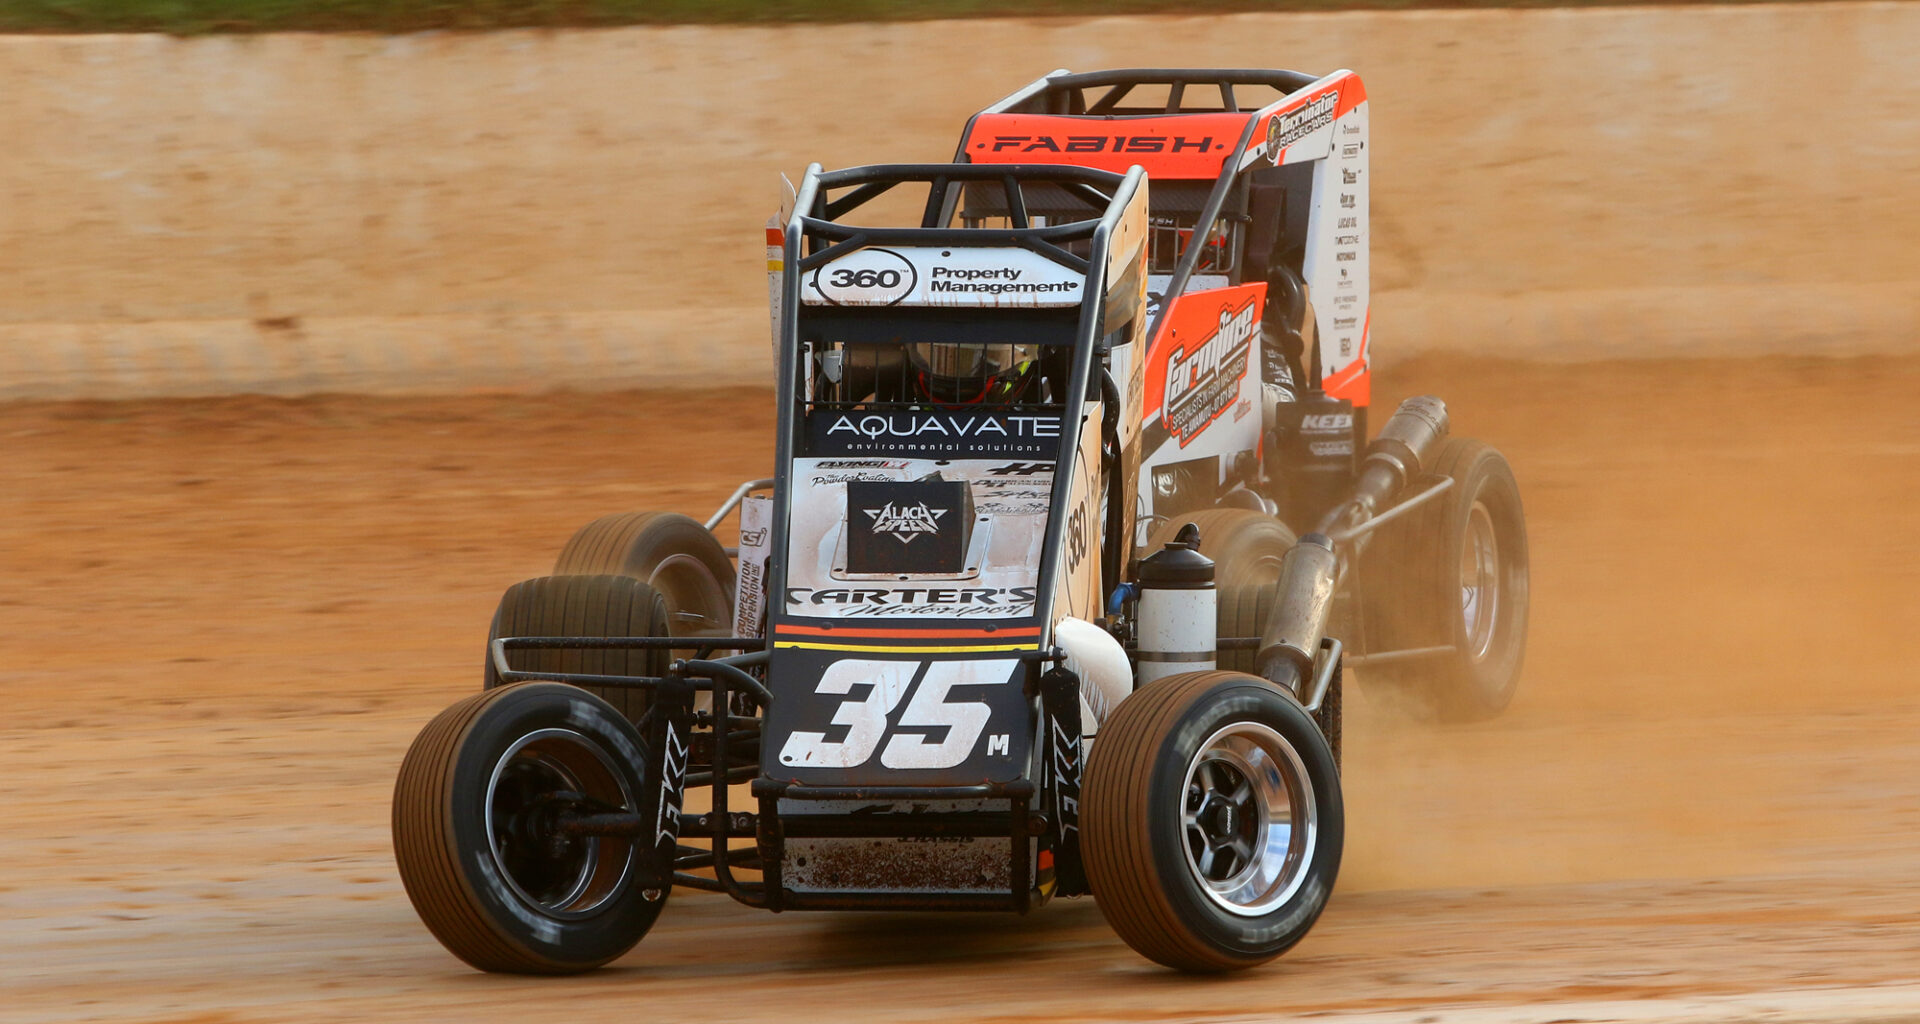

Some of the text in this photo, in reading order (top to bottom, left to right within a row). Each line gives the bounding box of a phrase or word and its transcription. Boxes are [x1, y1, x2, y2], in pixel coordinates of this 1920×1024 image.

[1280, 91, 1337, 135] Terminator
[992, 136, 1213, 153] FABISH
[931, 267, 1022, 281] Property
[931, 281, 1072, 295] Management
[827, 415, 1061, 440] AQUAVATE
[847, 443, 1041, 452] environmental solutions
[1068, 500, 1087, 575] 360
[737, 560, 751, 635] COMPETITION
[787, 586, 1036, 605] CARTER'S
[745, 576, 760, 639] SUSPENSION
[839, 601, 1035, 617] Motorsport
[779, 658, 1021, 769] 35
